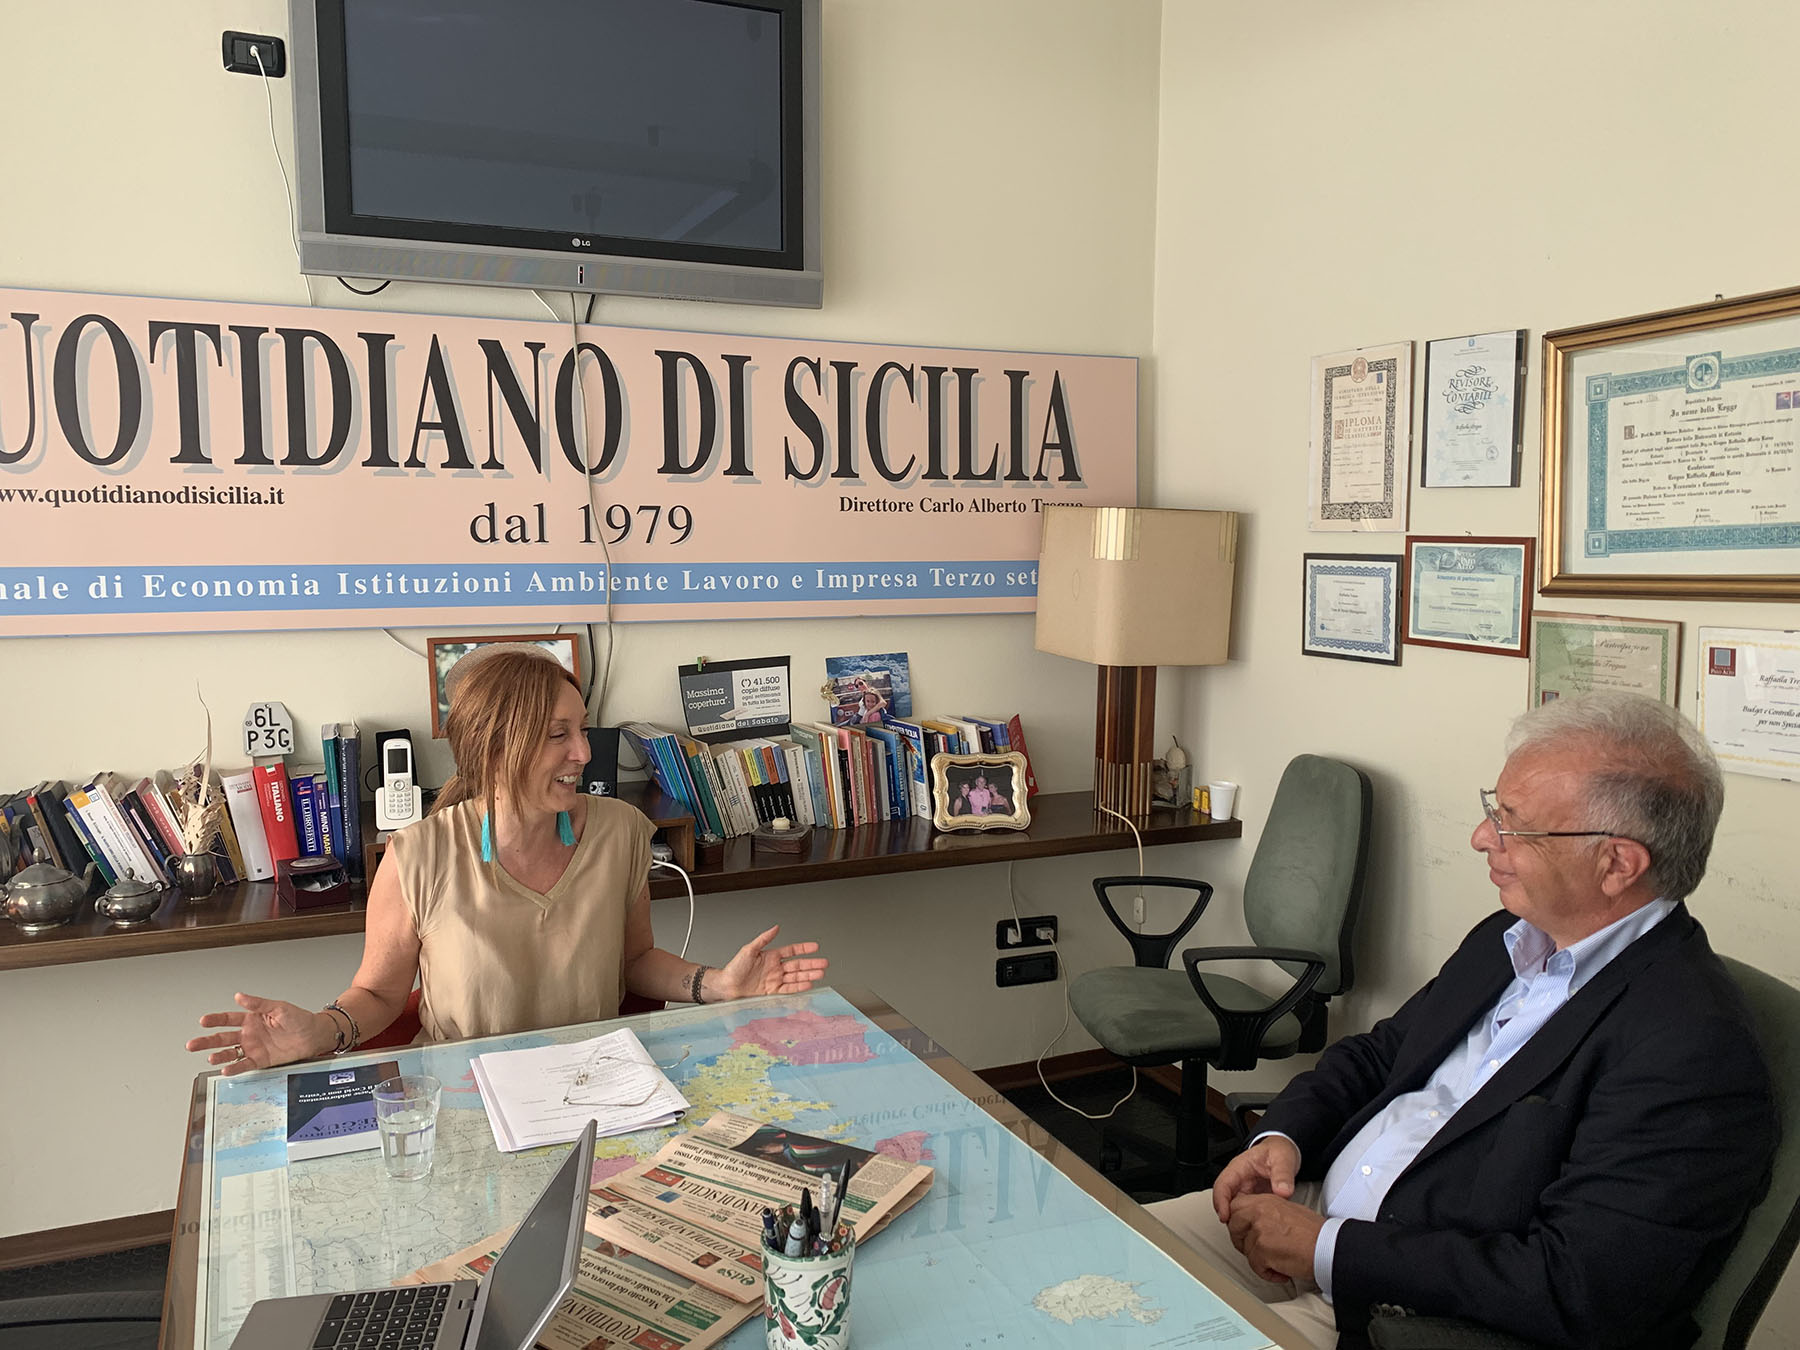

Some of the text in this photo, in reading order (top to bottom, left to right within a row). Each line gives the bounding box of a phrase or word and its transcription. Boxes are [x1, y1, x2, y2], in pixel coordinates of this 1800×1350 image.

[1449, 376, 1494, 391] REVISORE
[1442, 391, 1492, 404] CONTABILE
[655, 350, 754, 476] DI
[784, 356, 1082, 482] SICILIA
[1670, 409, 1680, 417] In
[1700, 405, 1715, 413] della
[1717, 403, 1738, 413] Legge
[840, 496, 914, 513] Direttore
[919, 497, 964, 513] Carlo
[968, 498, 1027, 513] Alberto
[470, 503, 694, 546] dal 1979
[88, 574, 123, 599] di
[142, 573, 320, 598] Economia
[337, 571, 512, 596] Istituzioni
[526, 571, 669, 595] Ambiente
[682, 569, 780, 591] Lavoro
[791, 573, 804, 589] e
[815, 567, 918, 592] Impresa
[929, 567, 995, 587] Terzo
[753, 676, 780, 686] 41.500
[1759, 675, 1788, 685] Raffaella
[686, 687, 724, 699] Massima
[741, 686, 758, 695] copie
[254, 707, 280, 728] 6L
[1742, 705, 1763, 716] Budget
[1769, 708, 1795, 718] Controllo
[697, 722, 735, 733] Quotidiano
[752, 717, 779, 726] Sabato
[270, 781, 285, 822] ITALIANO
[320, 811, 328, 833] MIND
[298, 1093, 352, 1104] addormentato
[673, 1150, 693, 1160] rosso
[692, 1154, 701, 1164] in
[703, 1149, 729, 1163] milioni
[729, 1157, 739, 1165] 16
[700, 1156, 720, 1168] conti
[723, 1163, 739, 1174] con
[739, 1159, 758, 1171] oltre
[744, 1171, 769, 1183] bilanci
[769, 1178, 792, 1190] senza
[678, 1179, 735, 1204] DI SICILIA
[668, 1221, 745, 1259] QUOTIDIANO
[593, 1264, 615, 1277] colpo
[637, 1282, 661, 1297] sussidi
[628, 1291, 660, 1310] Mercato
[662, 1293, 676, 1303] Da
